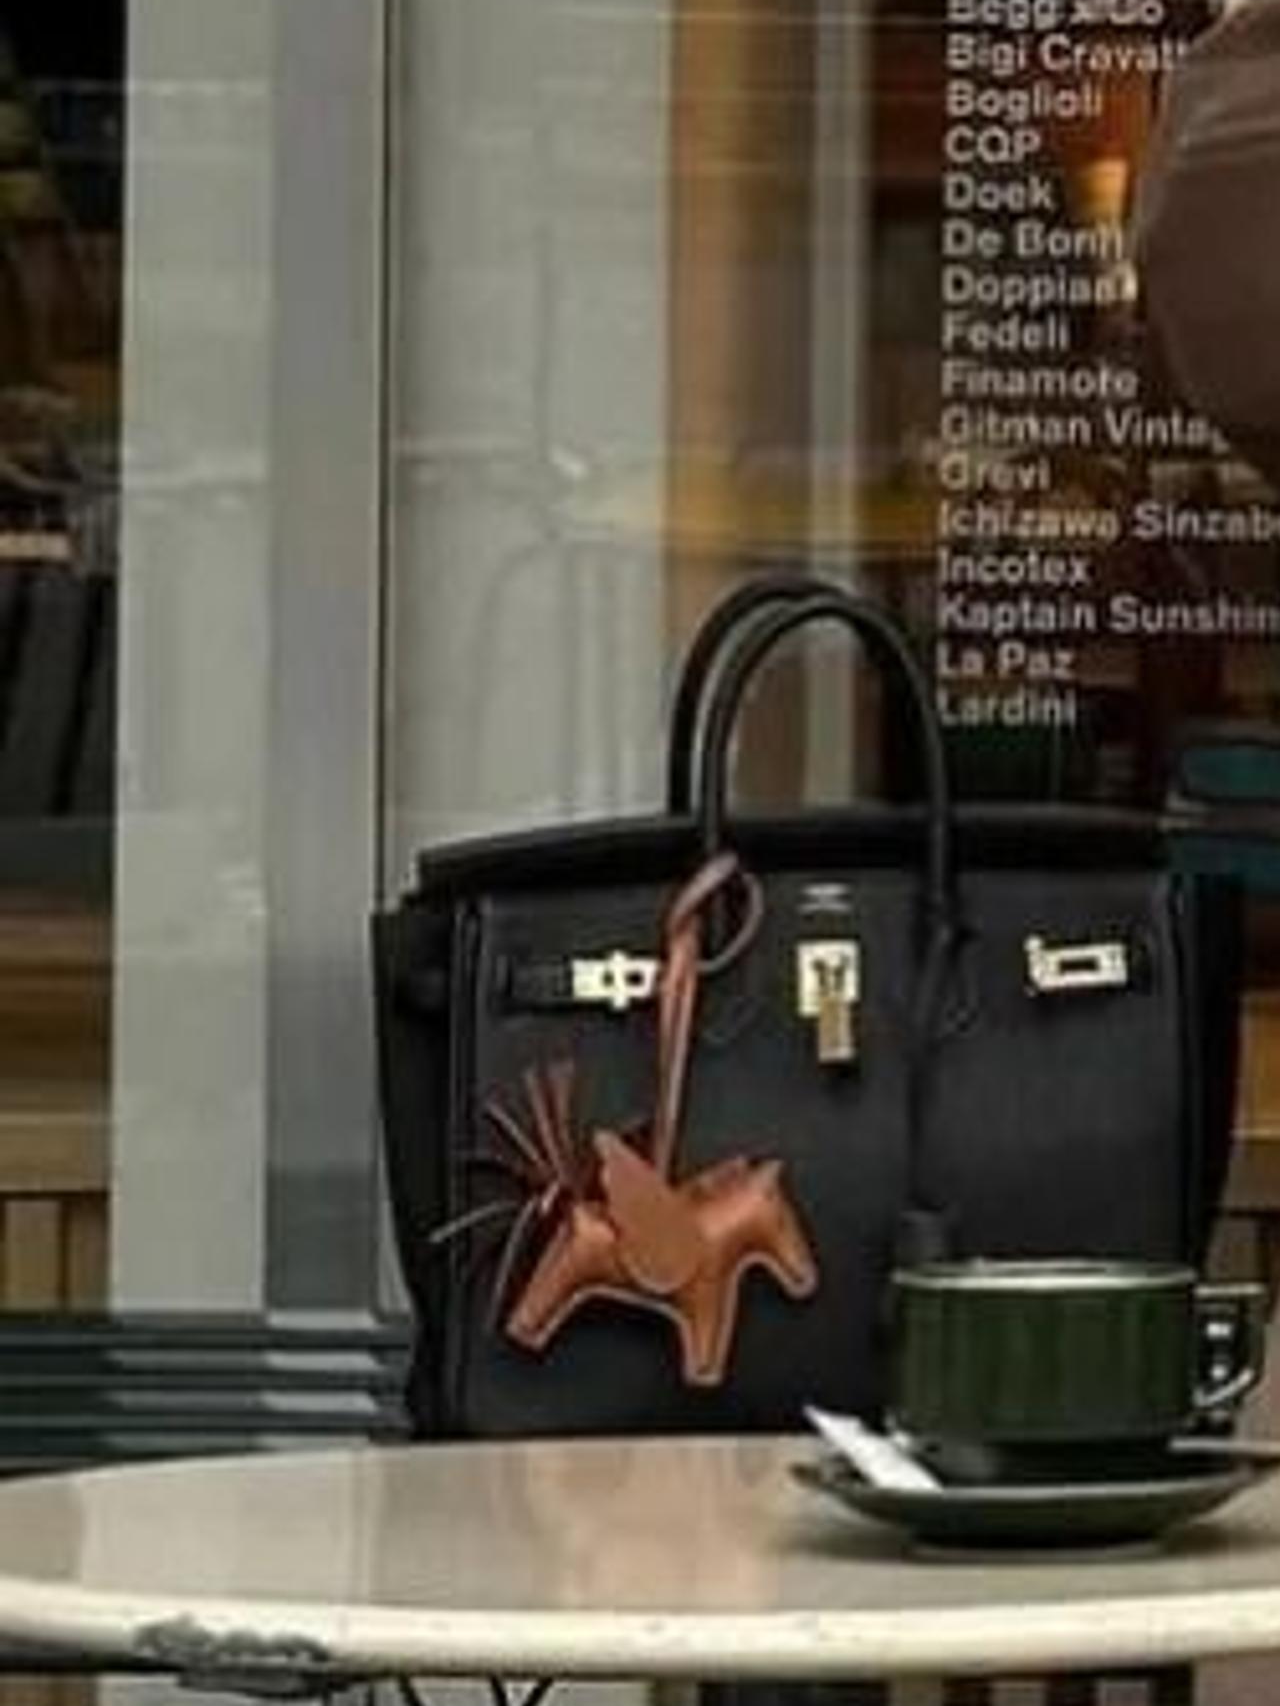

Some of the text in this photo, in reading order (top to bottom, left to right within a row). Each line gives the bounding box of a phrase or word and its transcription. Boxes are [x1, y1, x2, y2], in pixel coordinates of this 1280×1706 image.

[943, 172, 1054, 211] Doek
[942, 219, 1003, 258] De
[941, 311, 1071, 350] Fedeli
[938, 546, 1094, 587] Incotex
[938, 594, 1097, 640] Kaptain
[937, 642, 1076, 680] La Paz
[937, 688, 1078, 728] Lardini
